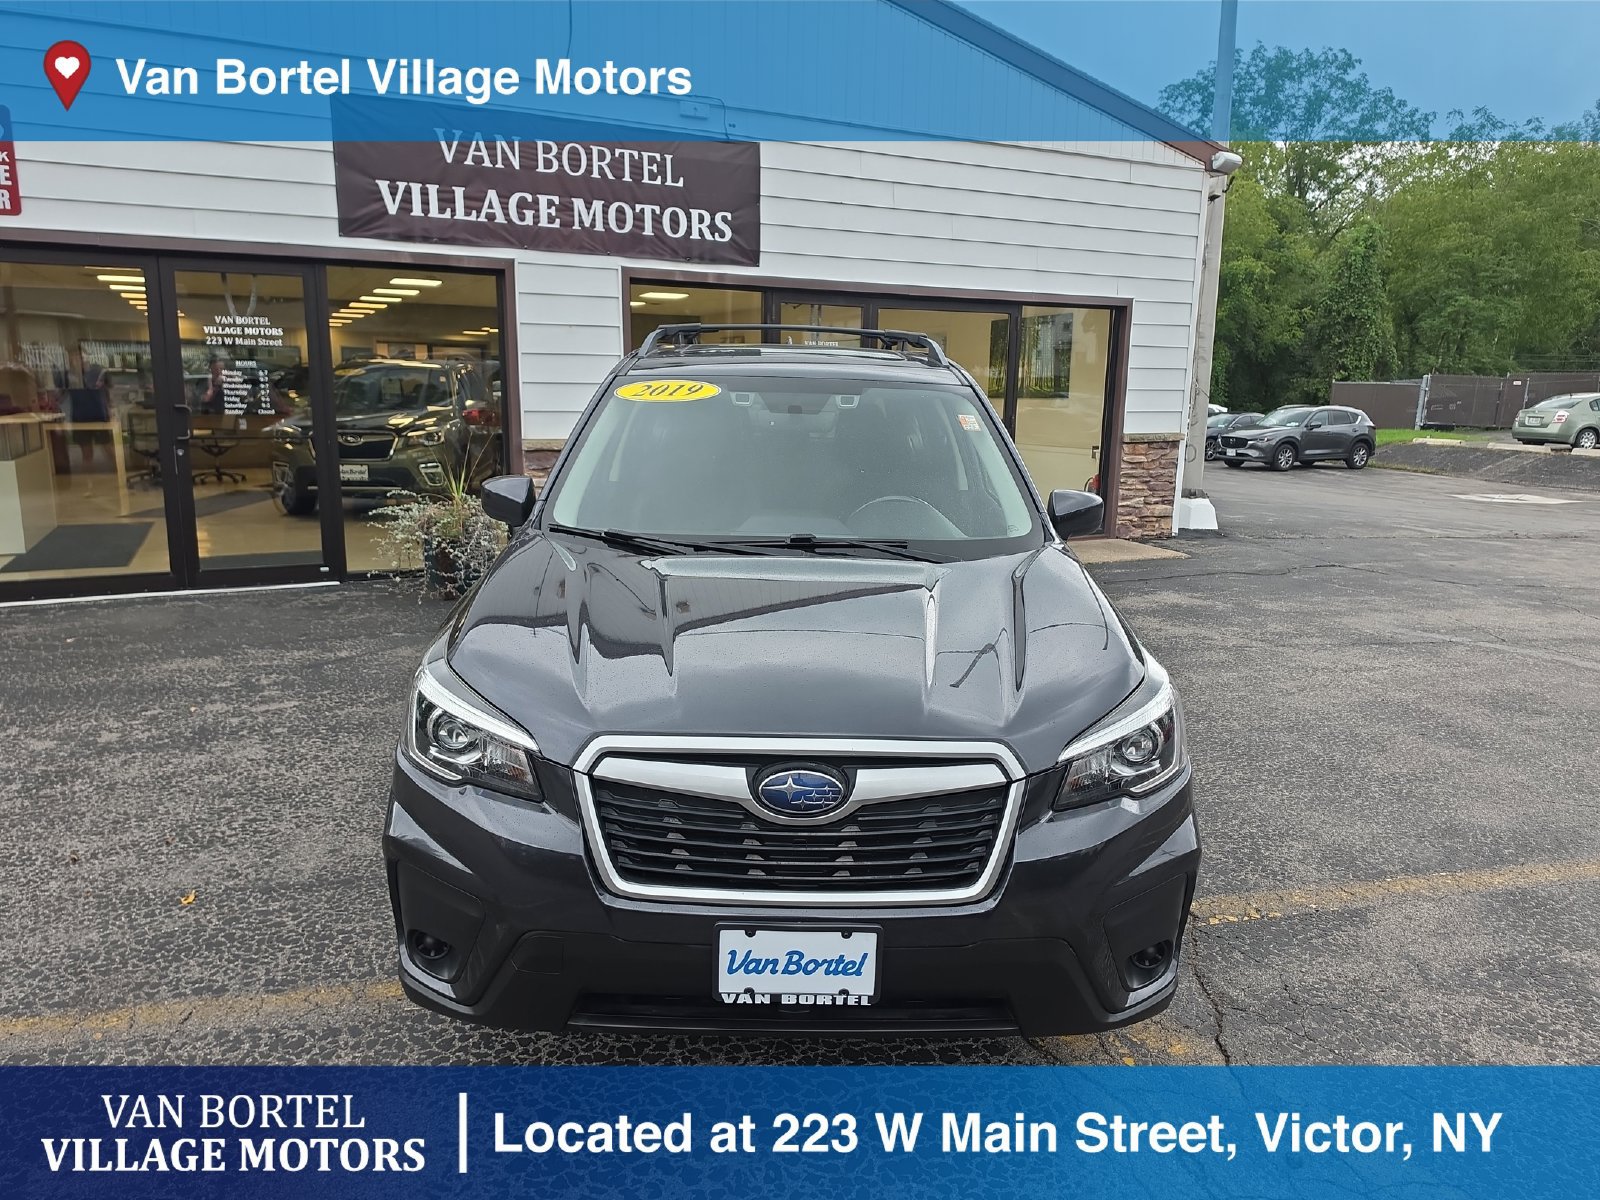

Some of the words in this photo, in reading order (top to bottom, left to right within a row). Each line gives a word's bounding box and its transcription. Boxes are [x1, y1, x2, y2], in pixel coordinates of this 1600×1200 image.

[433, 128, 520, 170] VAN
[535, 139, 684, 187] BORTEL
[375, 179, 561, 229] VILLAGE
[571, 197, 733, 242] MOTORS
[215, 316, 233, 324] VAN
[235, 316, 270, 325] BORTEL
[203, 326, 242, 335] VILLAGE
[244, 327, 283, 336] MOTORS
[206, 336, 222, 345] 223
[224, 337, 233, 345] W
[235, 337, 256, 346] Main
[258, 337, 283, 346] Street
[631, 384, 704, 397] 2019
[727, 950, 779, 975] Van
[781, 951, 868, 976] Bortel
[721, 993, 770, 1004] VAN
[781, 994, 871, 1005] BORTEL
